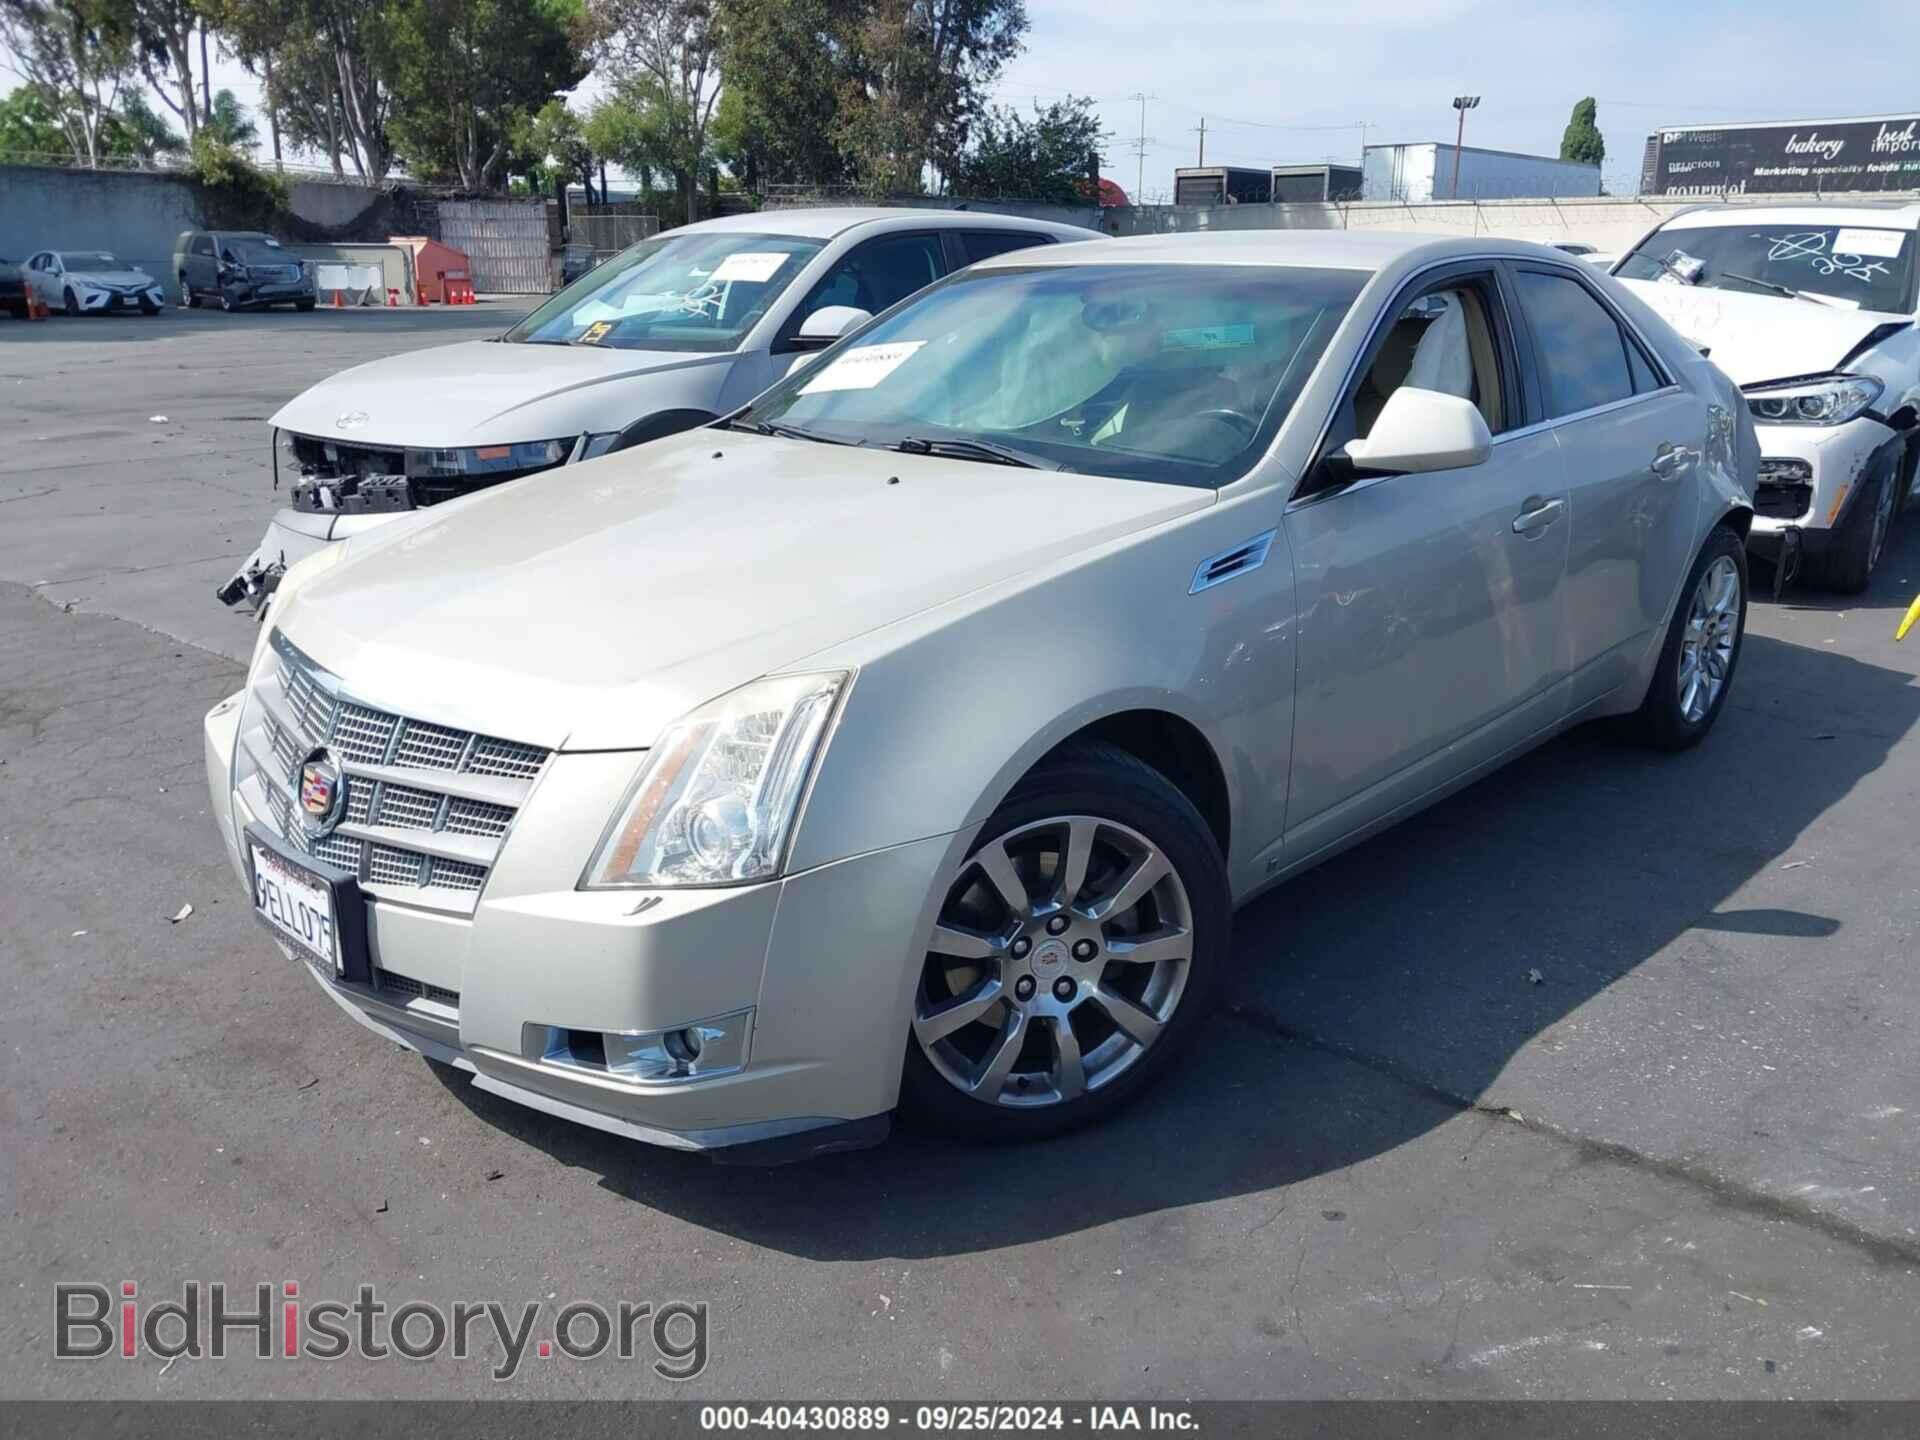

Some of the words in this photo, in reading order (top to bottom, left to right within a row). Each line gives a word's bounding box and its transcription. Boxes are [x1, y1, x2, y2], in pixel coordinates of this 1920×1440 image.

[1785, 132, 1845, 160] bakery
[1871, 139, 1920, 154] impor
[1753, 165, 1809, 176] Marketing
[1867, 163, 1900, 172] foods
